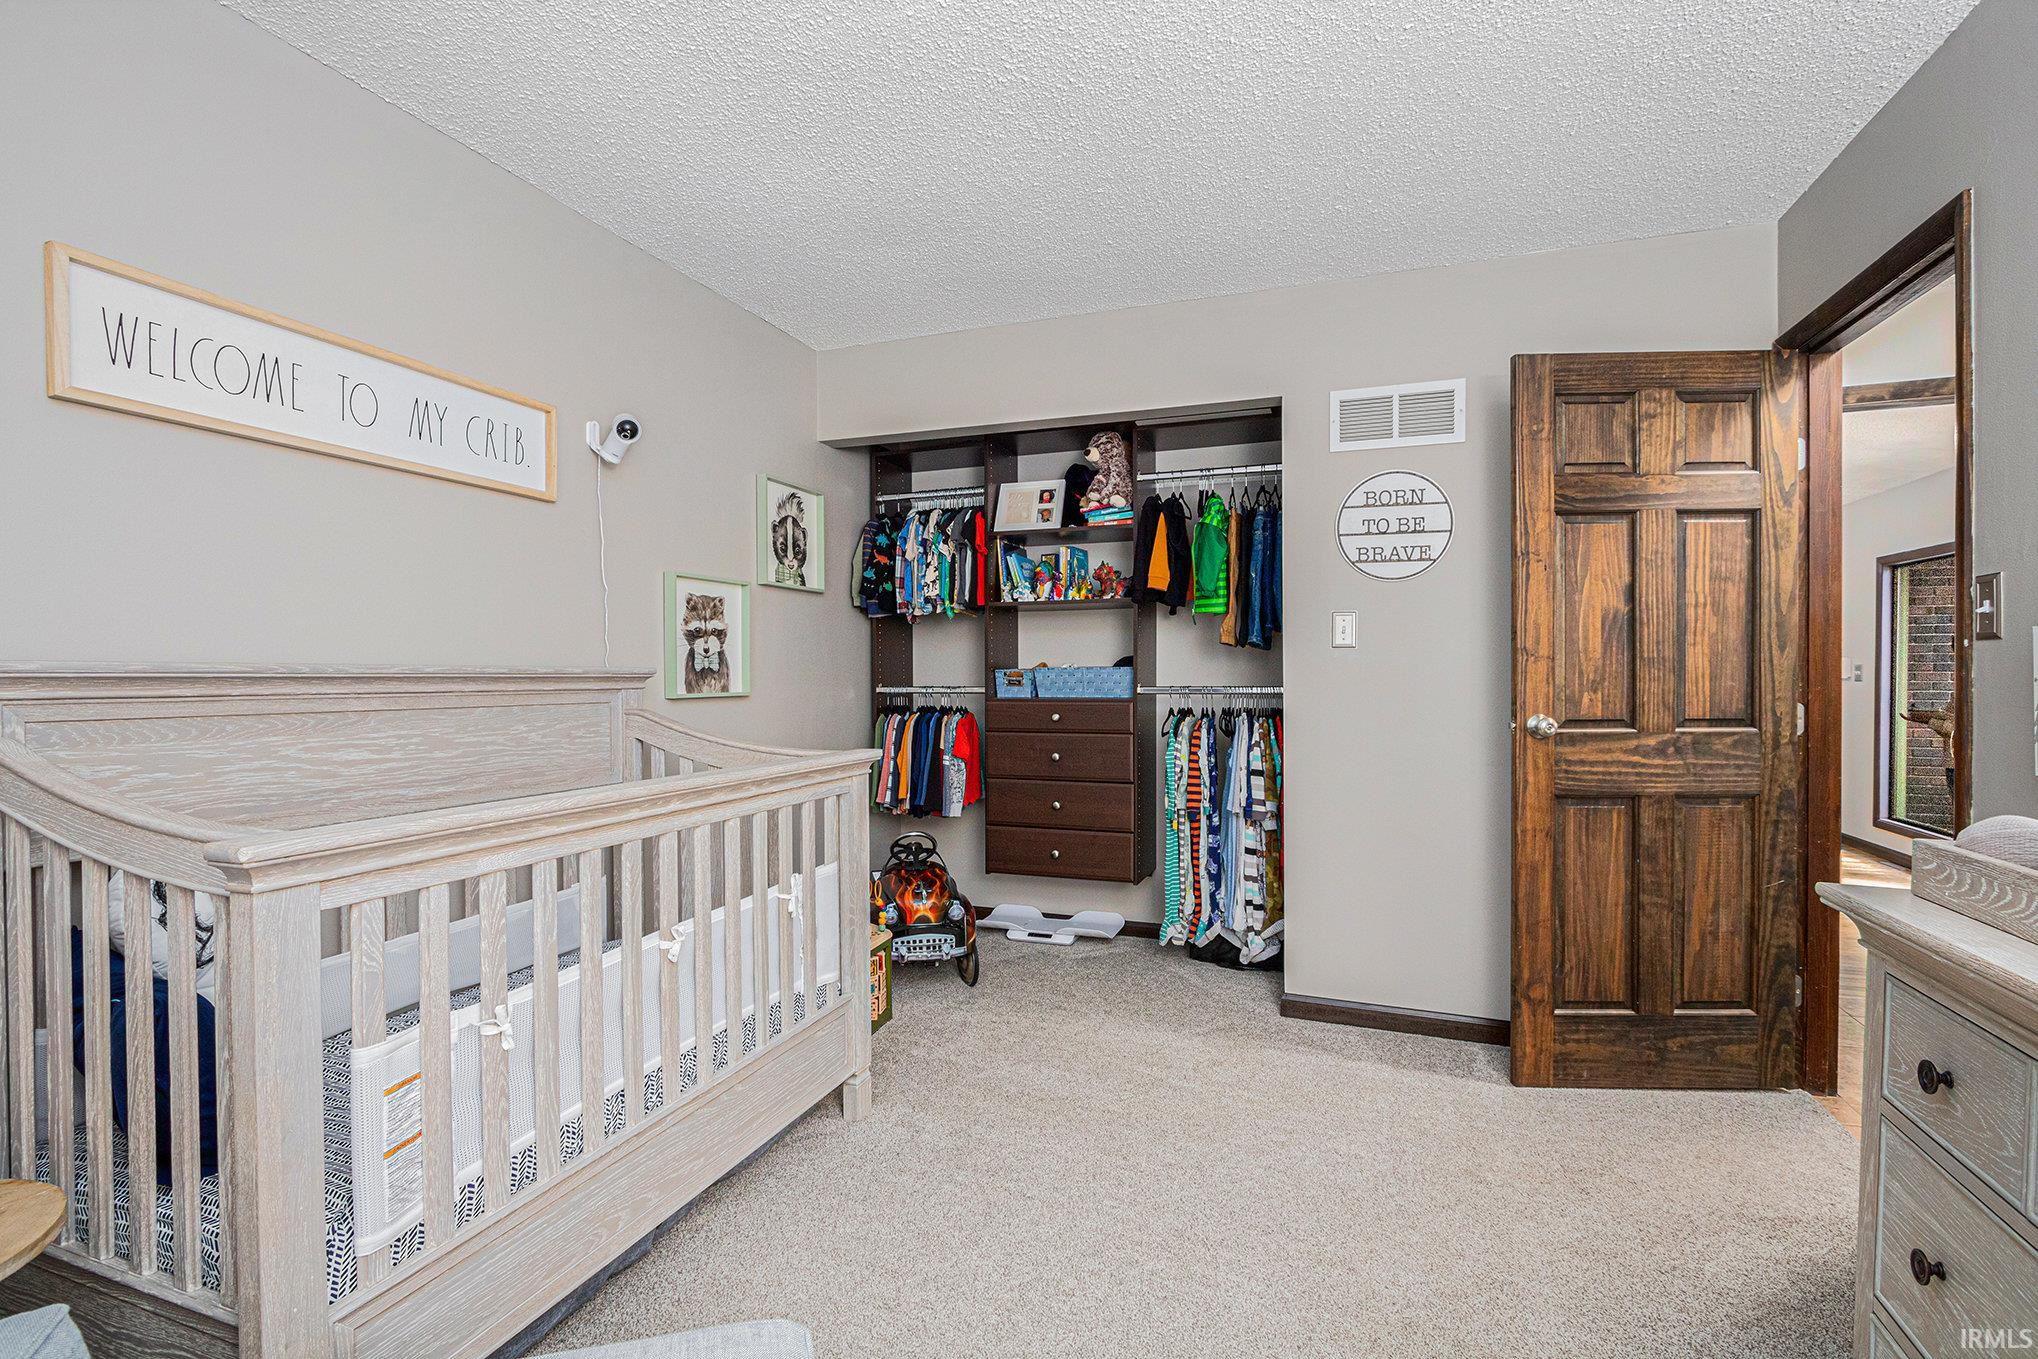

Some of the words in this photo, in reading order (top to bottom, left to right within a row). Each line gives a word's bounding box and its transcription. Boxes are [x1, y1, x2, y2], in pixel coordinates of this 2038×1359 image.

[101, 306, 304, 413] WELCOME
[337, 373, 379, 428] TO
[408, 396, 448, 447] MY
[465, 415, 531, 469] CRIB.
[1363, 488, 1426, 507] BORN
[1362, 517, 1390, 535] TO
[1395, 516, 1426, 533] BE
[1355, 544, 1432, 562] BRAVE
